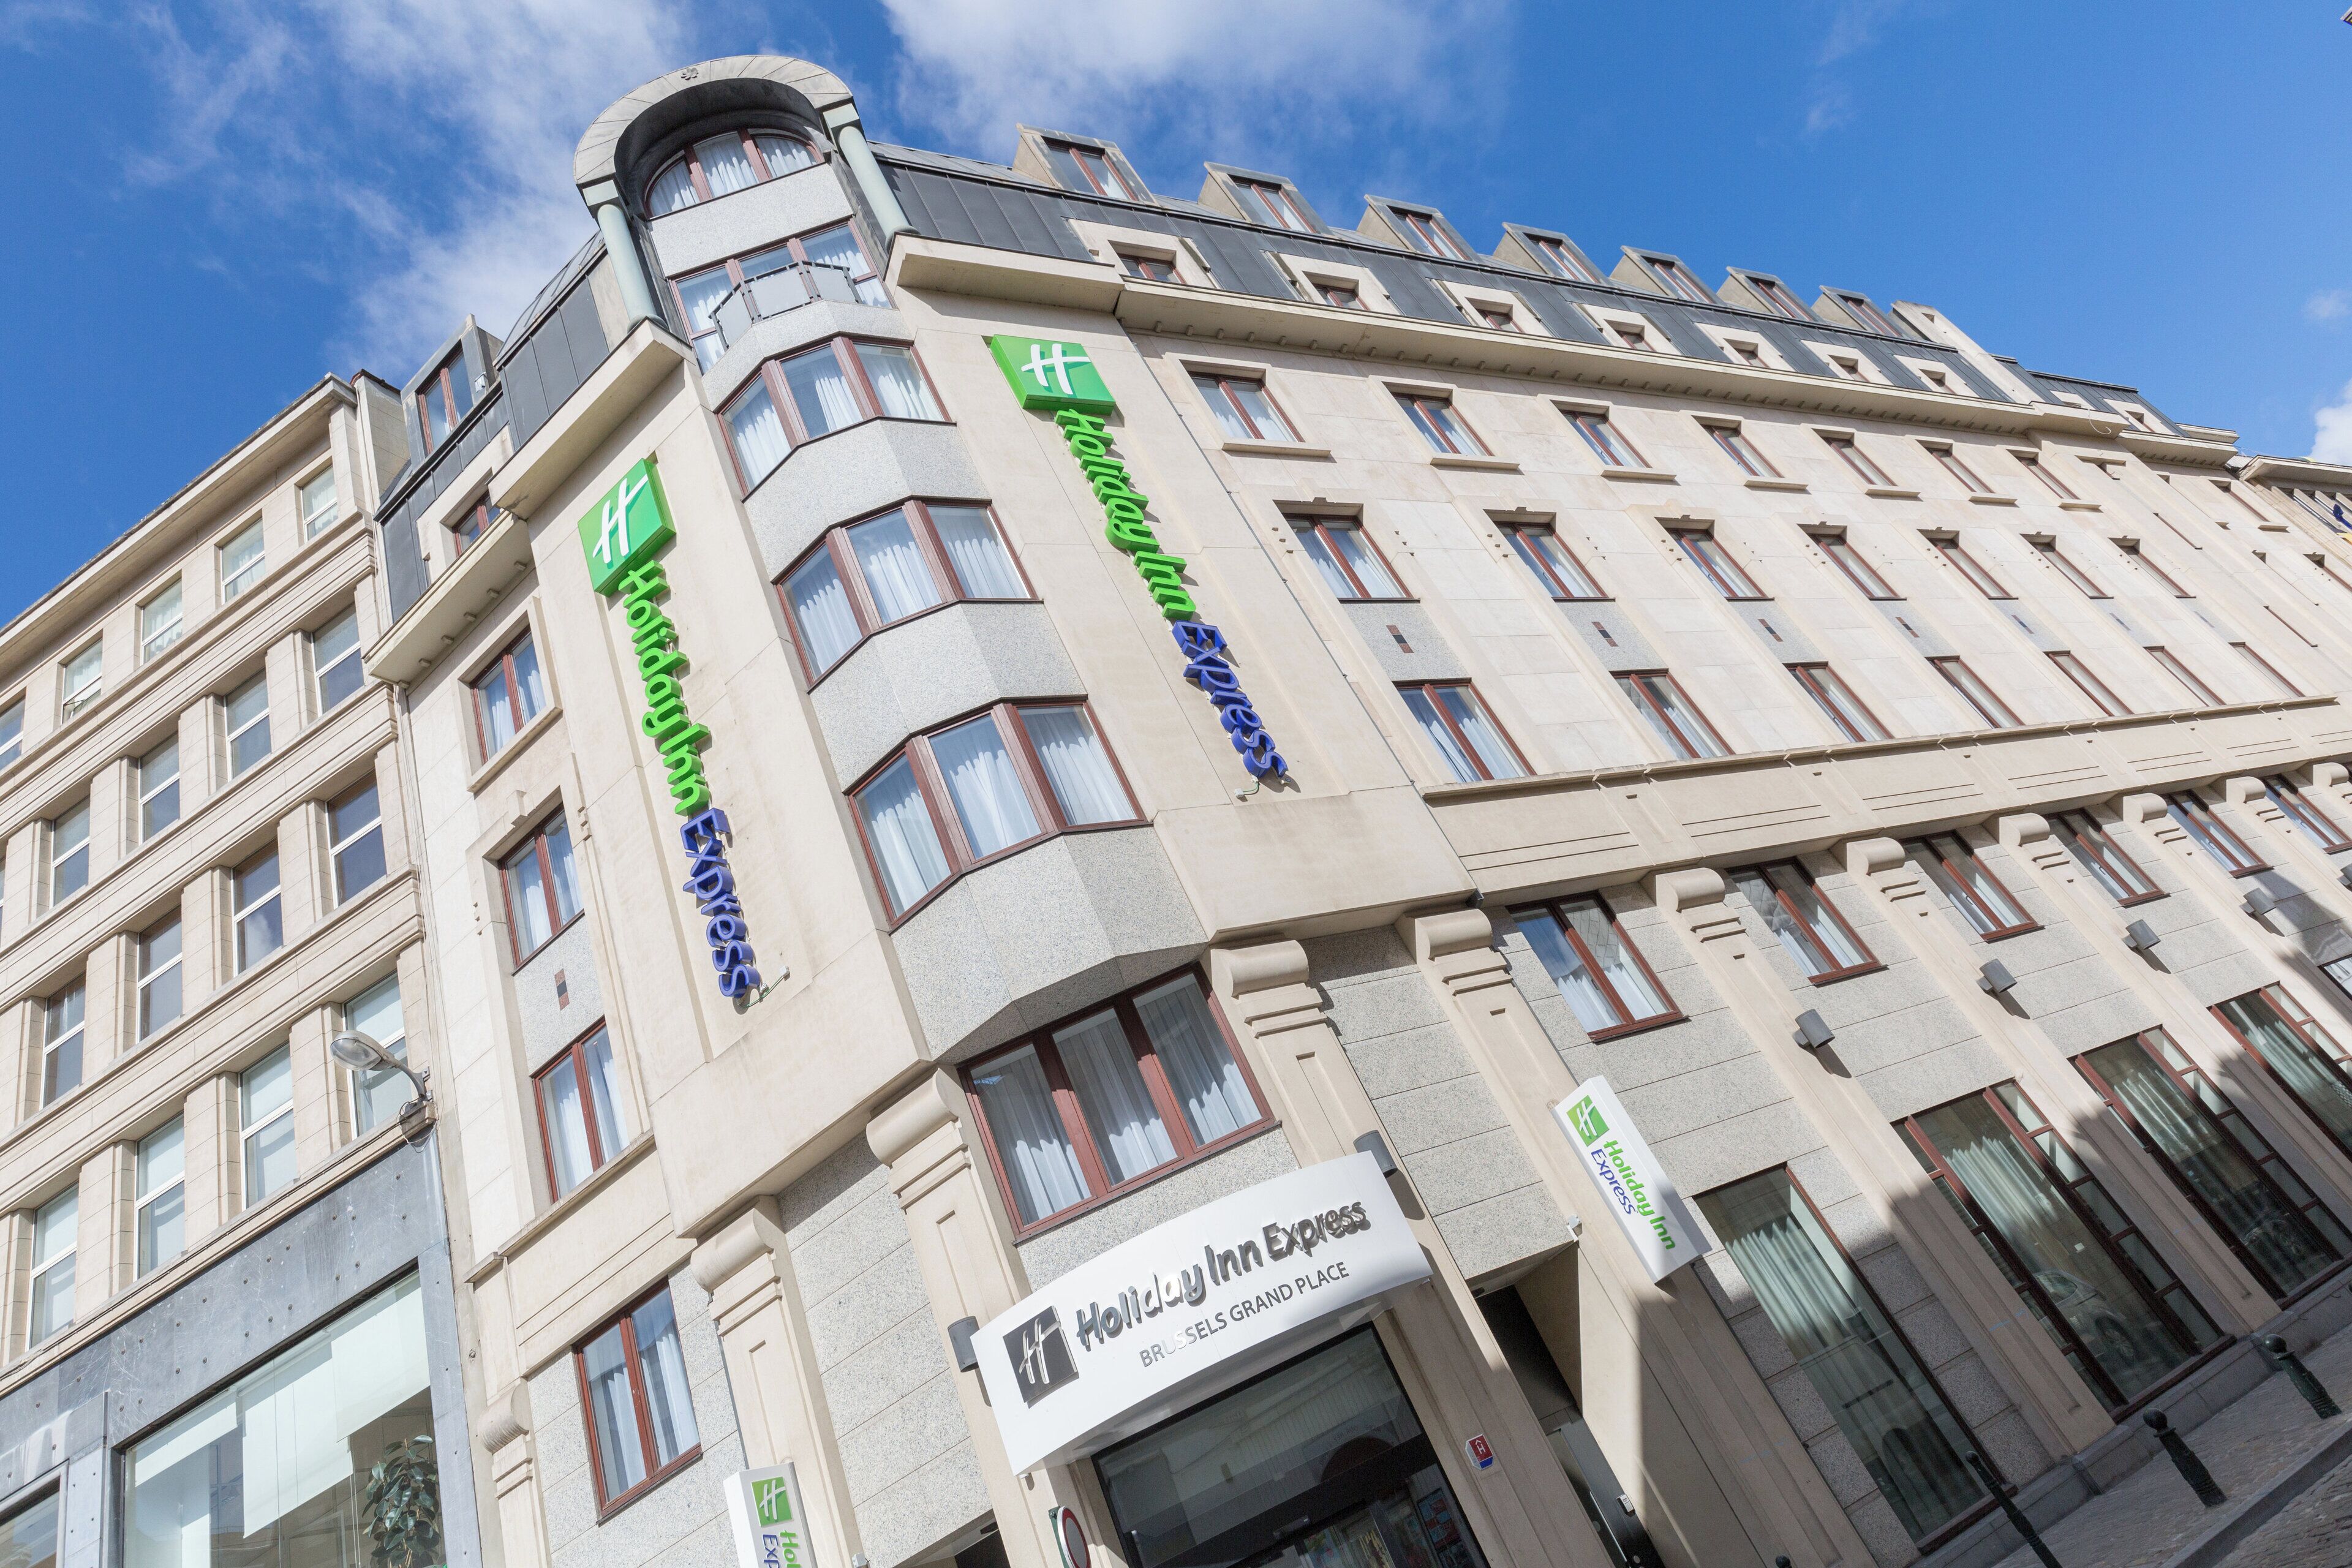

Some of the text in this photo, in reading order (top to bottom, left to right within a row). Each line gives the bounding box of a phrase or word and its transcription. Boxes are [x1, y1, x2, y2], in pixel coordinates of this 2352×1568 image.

[1054, 409, 1289, 778] Holiday Inn Express
[618, 560, 762, 999] Holiday Inn Express
[1591, 1148, 1637, 1215] Express
[1604, 1140, 1676, 1251] Holiday Inn
[1076, 1202, 1368, 1349] Holiday Inn Express
[1139, 1261, 1349, 1368] BRUSSELS GRAND PLACE
